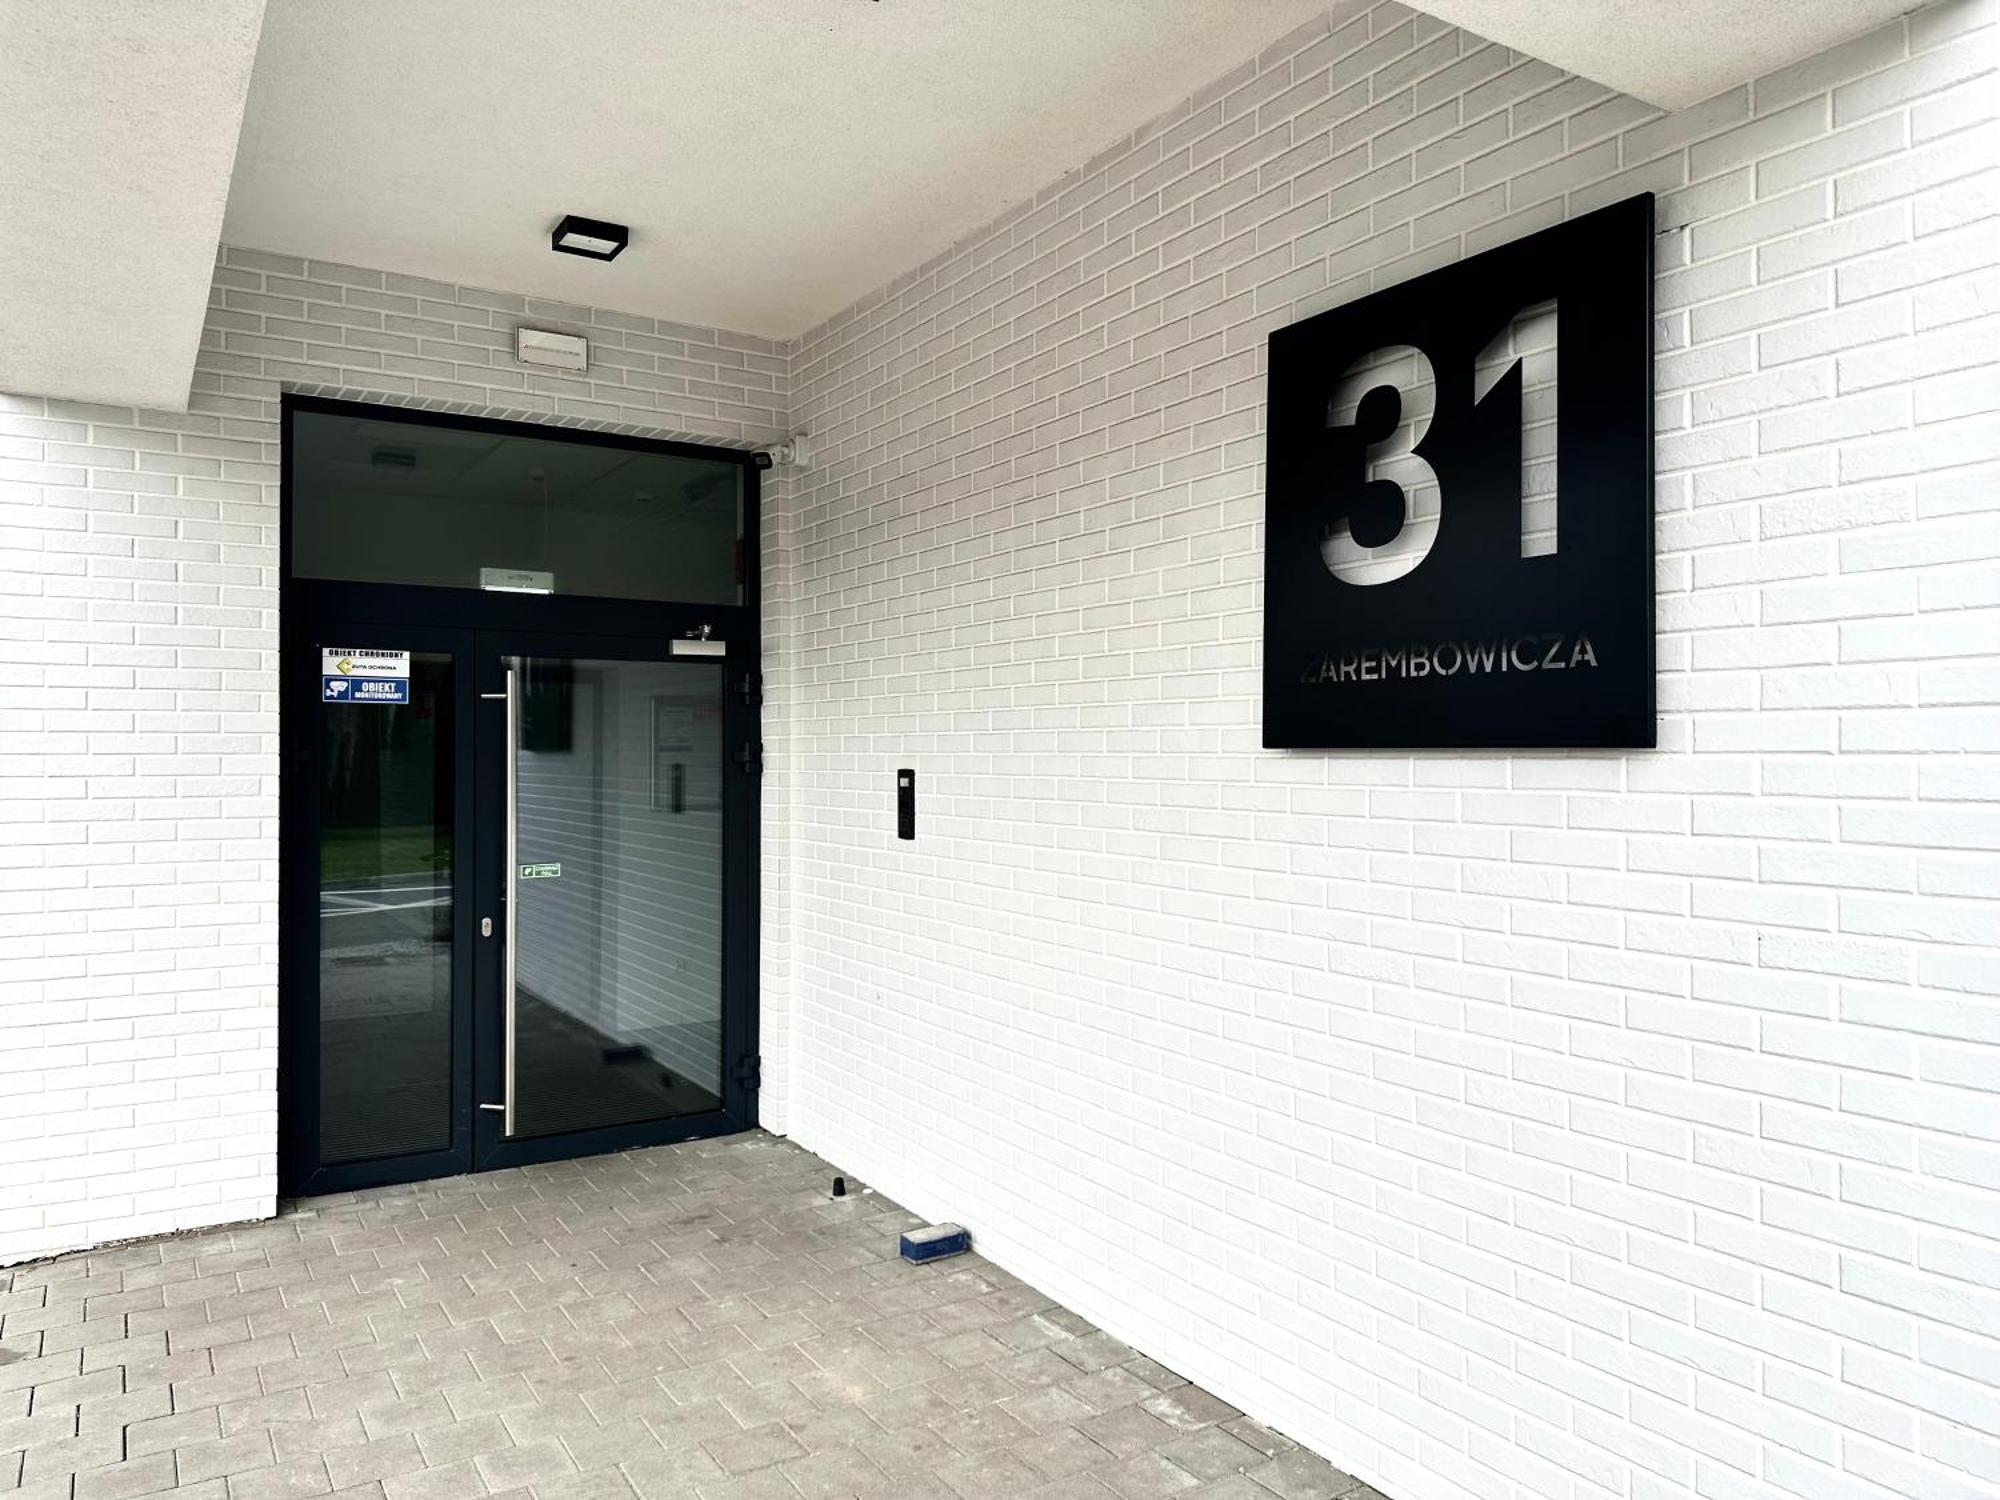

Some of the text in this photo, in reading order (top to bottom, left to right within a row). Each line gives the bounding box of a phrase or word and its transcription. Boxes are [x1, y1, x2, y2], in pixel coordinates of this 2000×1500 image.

[1320, 298, 1558, 586] 31
[359, 650, 403, 658] CHRONIONY
[1300, 631, 1598, 683] ZAREMBOWICZA
[362, 682, 396, 692] OBIEKT
